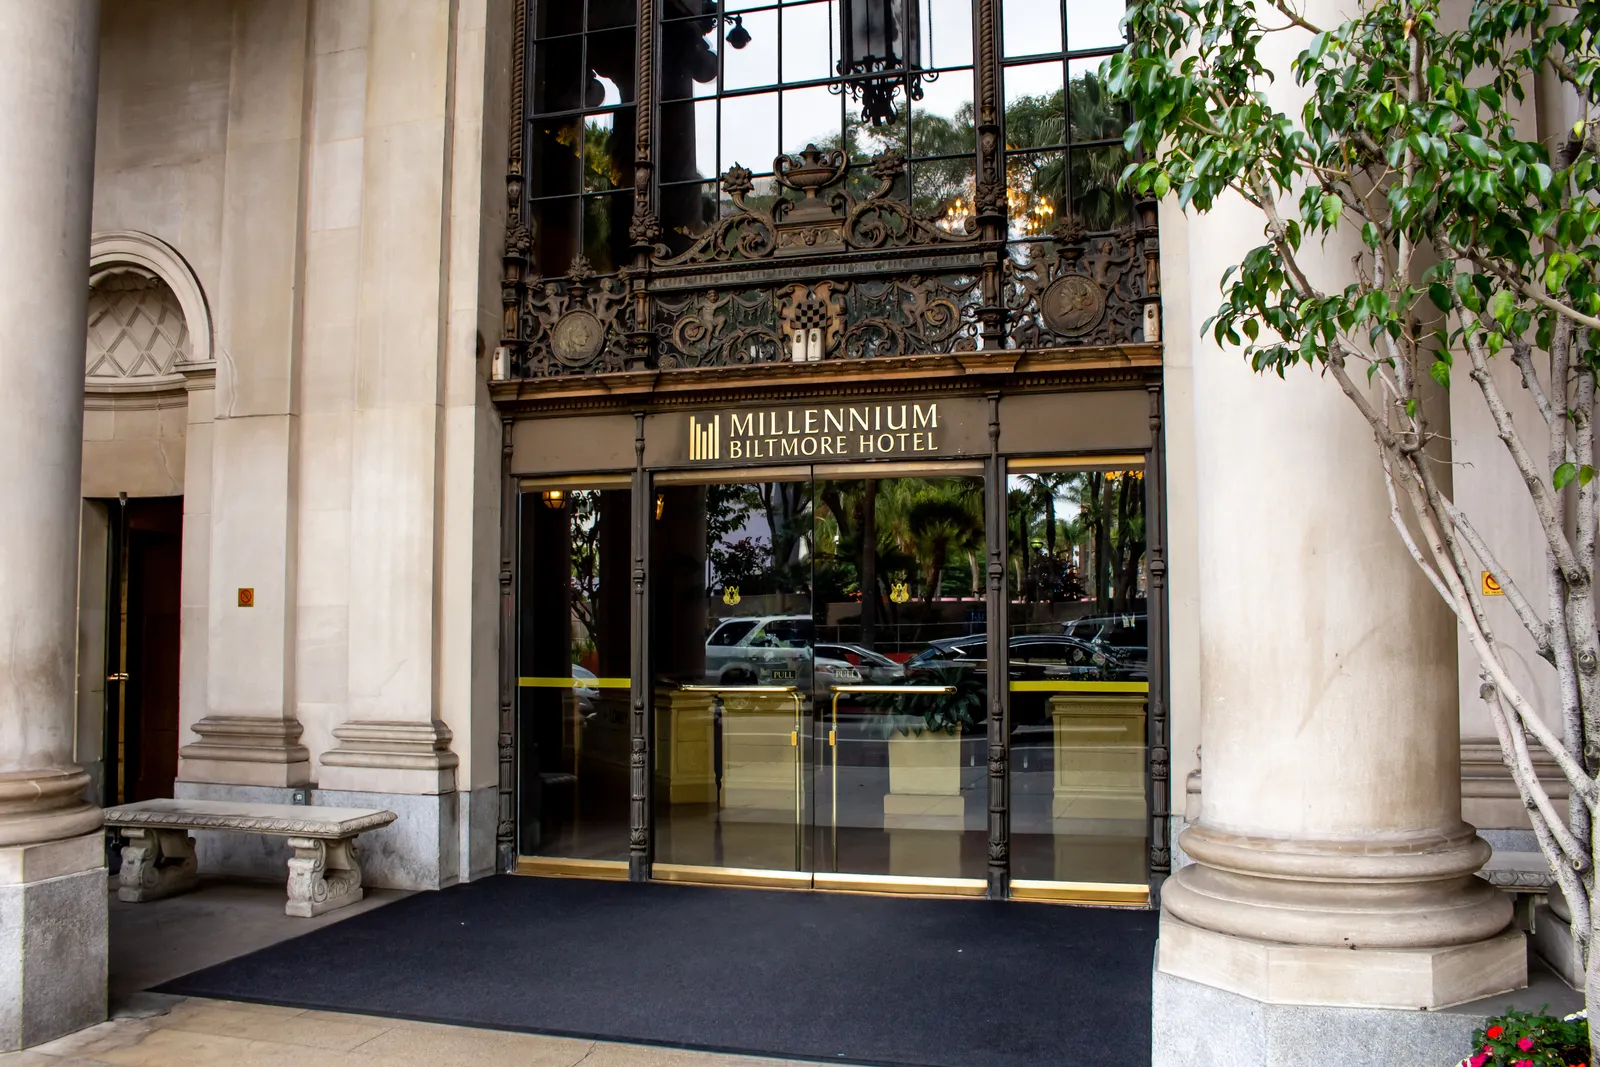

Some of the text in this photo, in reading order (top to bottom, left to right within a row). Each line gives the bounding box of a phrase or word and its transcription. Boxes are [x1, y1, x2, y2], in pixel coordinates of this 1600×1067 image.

[730, 403, 938, 437] MILLENNIUM
[730, 432, 939, 459] BILTMORE HOTEL
[773, 670, 794, 679] PULL
[835, 670, 856, 678] PULL
